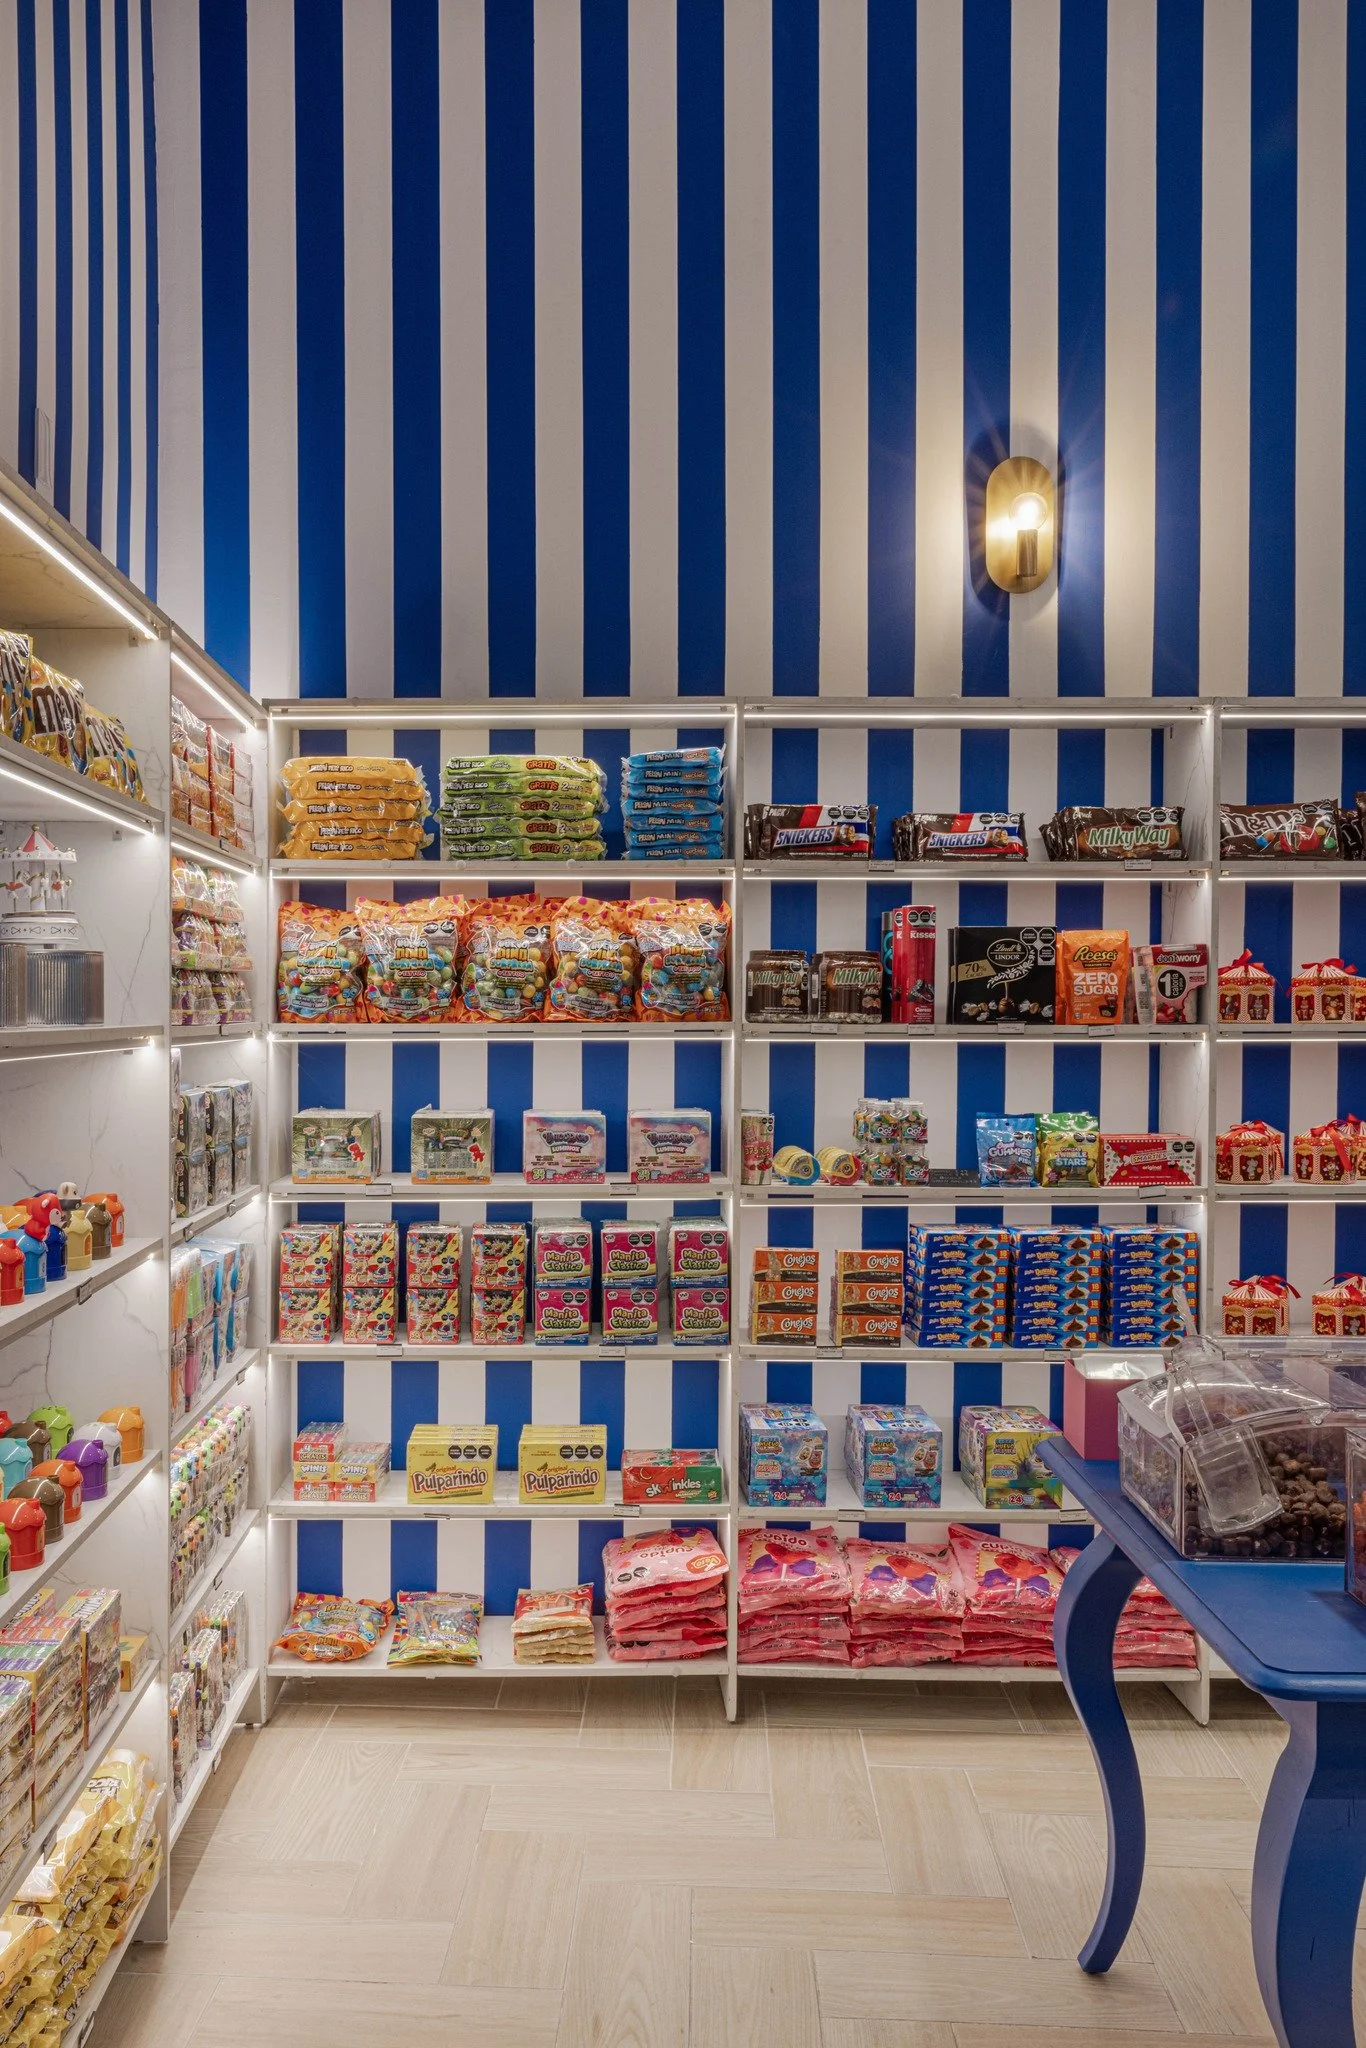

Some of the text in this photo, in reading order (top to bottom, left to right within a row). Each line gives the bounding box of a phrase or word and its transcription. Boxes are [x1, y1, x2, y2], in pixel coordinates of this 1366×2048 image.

[776, 827, 834, 845] SNICKERS
[928, 832, 987, 847] SNICKERS
[1073, 945, 1118, 962] Reese's
[1073, 972, 1118, 986] ZERO
[1159, 973, 1171, 997] 1
[1074, 985, 1118, 996] SUGAR
[1056, 1158, 1087, 1166] STARS
[546, 1251, 580, 1260] Manita
[611, 1250, 646, 1260] Manita
[683, 1249, 718, 1260] Manita
[783, 1253, 816, 1269] Conejos
[867, 1254, 899, 1269] Conejos
[781, 1285, 815, 1300] Conejos
[866, 1286, 898, 1300] Conejos
[544, 1308, 578, 1318] Manita
[614, 1308, 648, 1319] Manita
[684, 1308, 719, 1318] Manita
[780, 1317, 813, 1332] Conejos
[865, 1319, 897, 1333] Conejos
[413, 1469, 487, 1491] Pulparindo
[526, 1468, 598, 1491] Pulparindo
[774, 1492, 787, 1500] 24
[1009, 1495, 1023, 1504] 24
[755, 1533, 808, 1546] cupido
[639, 1547, 694, 1558] cupido
